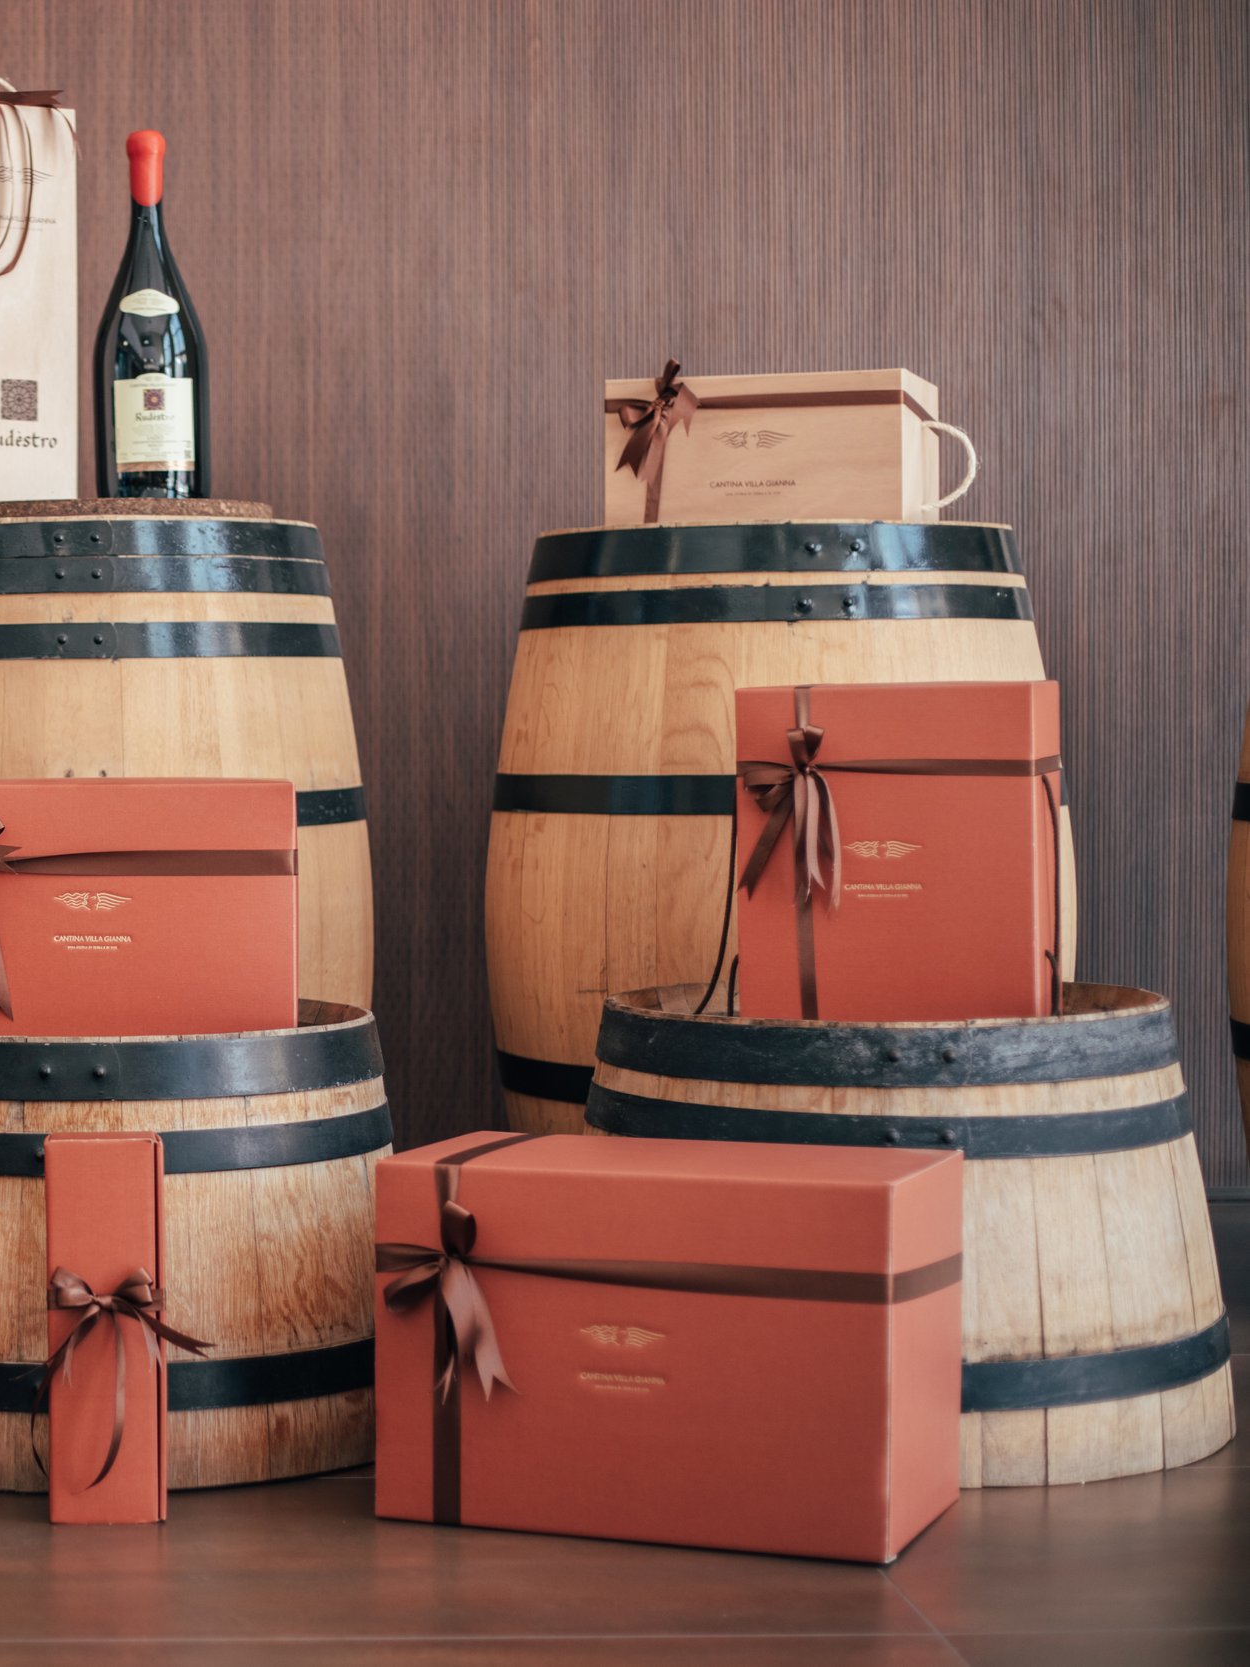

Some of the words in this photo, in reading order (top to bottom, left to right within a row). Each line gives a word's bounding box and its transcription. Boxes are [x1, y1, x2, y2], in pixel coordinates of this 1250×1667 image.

[844, 883, 875, 891] CANTINA
[894, 882, 923, 891] GIANNA
[104, 935, 132, 943] GIANNA
[614, 1373, 634, 1382] VILLA
